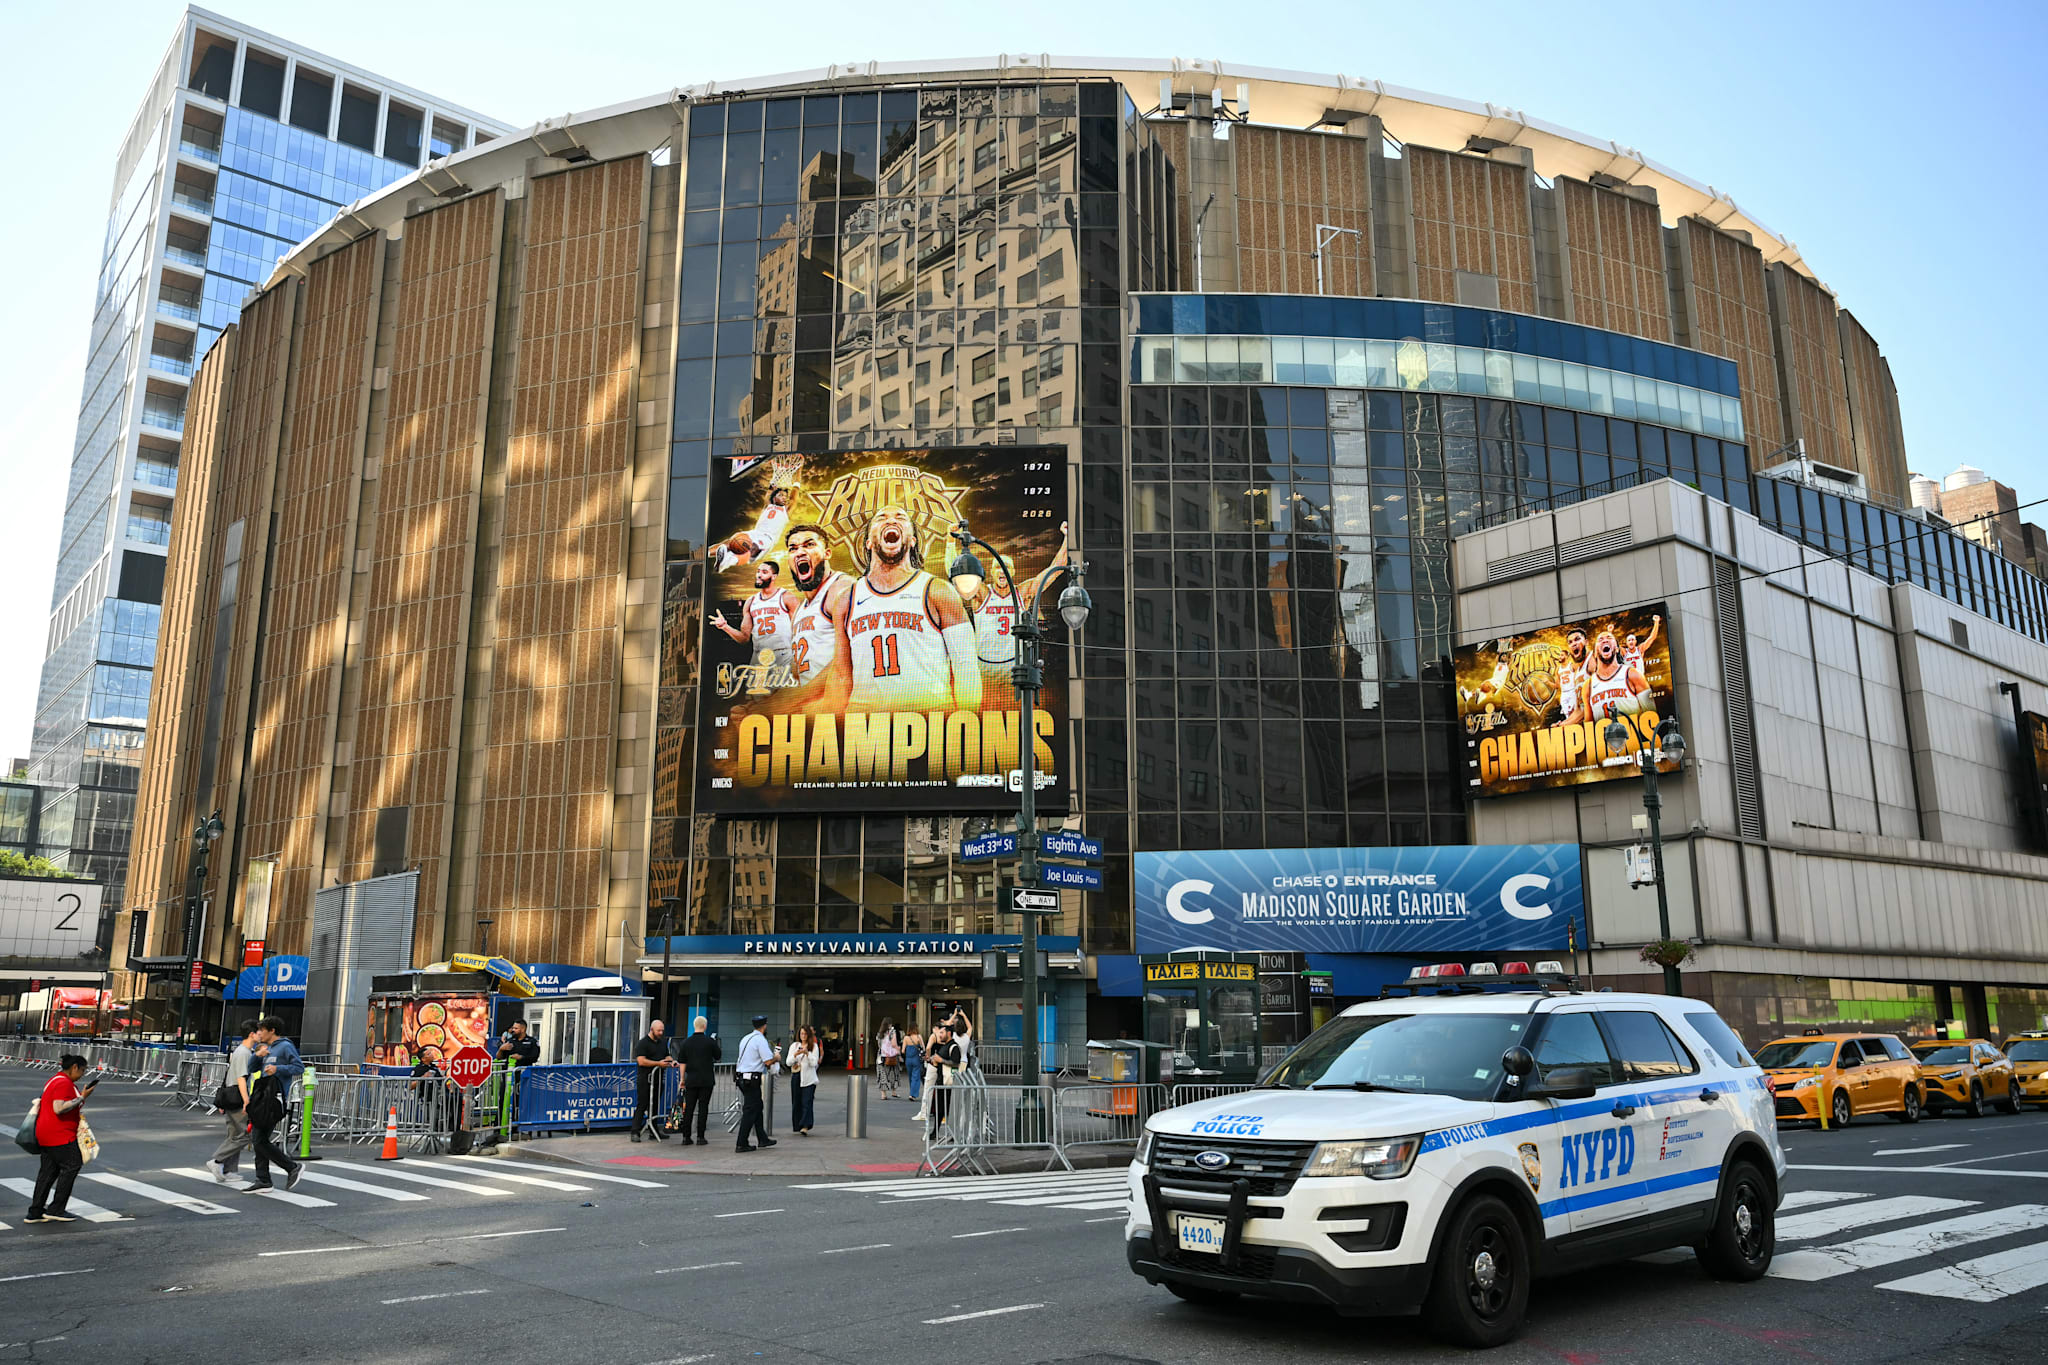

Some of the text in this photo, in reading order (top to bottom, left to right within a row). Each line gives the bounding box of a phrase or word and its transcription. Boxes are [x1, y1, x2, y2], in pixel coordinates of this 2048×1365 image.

[862, 467, 918, 480] NEW YORK
[822, 476, 958, 527] KNICKS
[757, 616, 776, 636] 25
[851, 611, 925, 638] NEW YORK
[997, 616, 1010, 636] 3
[871, 633, 901, 678] 11
[724, 664, 799, 699] Finals
[1606, 688, 1627, 699] YORK
[738, 710, 1055, 788] CHAMPIONS
[964, 838, 1013, 856] West 33rd St
[1046, 837, 1097, 855] Eighth Ave
[1046, 869, 1061, 881] Joe
[1063, 870, 1084, 883] Louis
[1273, 874, 1437, 888] CHASE ENTRANCE
[1020, 896, 1032, 904] ONE
[1165, 879, 1214, 925] C
[1242, 889, 1467, 919] MADISON SQUARE GARDEN
[1499, 873, 1553, 921] C
[55, 893, 81, 930] 2
[744, 940, 974, 953] PENNSYLVANIA STATION
[455, 956, 486, 967] SABRETT
[277, 963, 293, 982] D
[1149, 964, 1181, 979] TAXI
[1206, 963, 1238, 978] TAXI
[531, 976, 559, 985] PLAZA
[1266, 993, 1292, 1005] GARDEN
[452, 1058, 490, 1075] STOP
[568, 1096, 633, 1107] WELCOME TO
[546, 1109, 580, 1121] THE
[1211, 1114, 1263, 1122] NYPD
[1664, 1116, 1688, 1130] COURTESY
[1191, 1121, 1264, 1136] POLICE
[1441, 1123, 1486, 1147] POLICE
[1662, 1130, 1704, 1145] PROFESSIONALISM
[1560, 1125, 1635, 1189] NYPD
[1659, 1146, 1682, 1160] RESPECT
[1182, 1225, 1212, 1244] 4420
